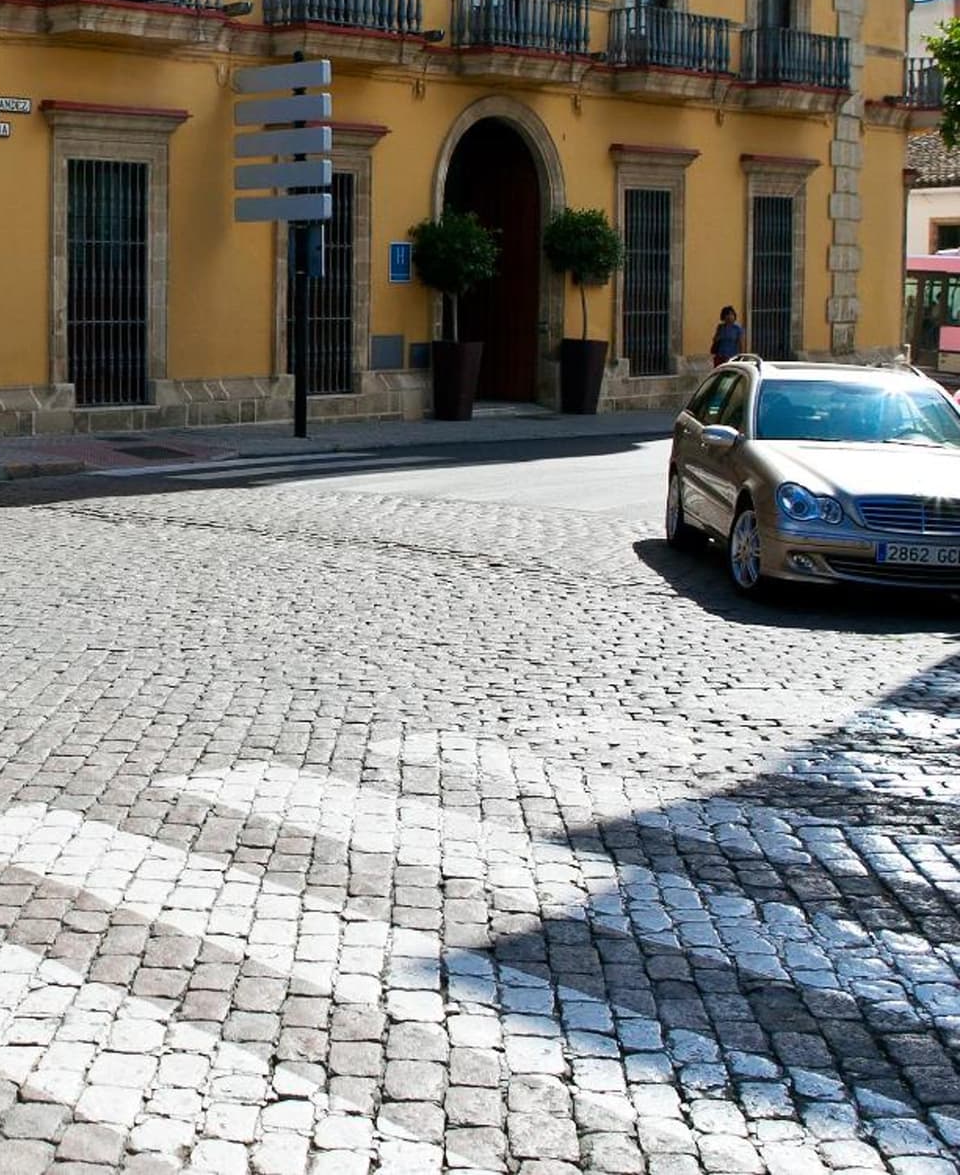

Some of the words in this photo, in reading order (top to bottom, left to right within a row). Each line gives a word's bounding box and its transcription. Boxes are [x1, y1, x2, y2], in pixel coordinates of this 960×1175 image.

[396, 247, 405, 265] H
[887, 545, 930, 563] 2862
[937, 548, 960, 564] GC
